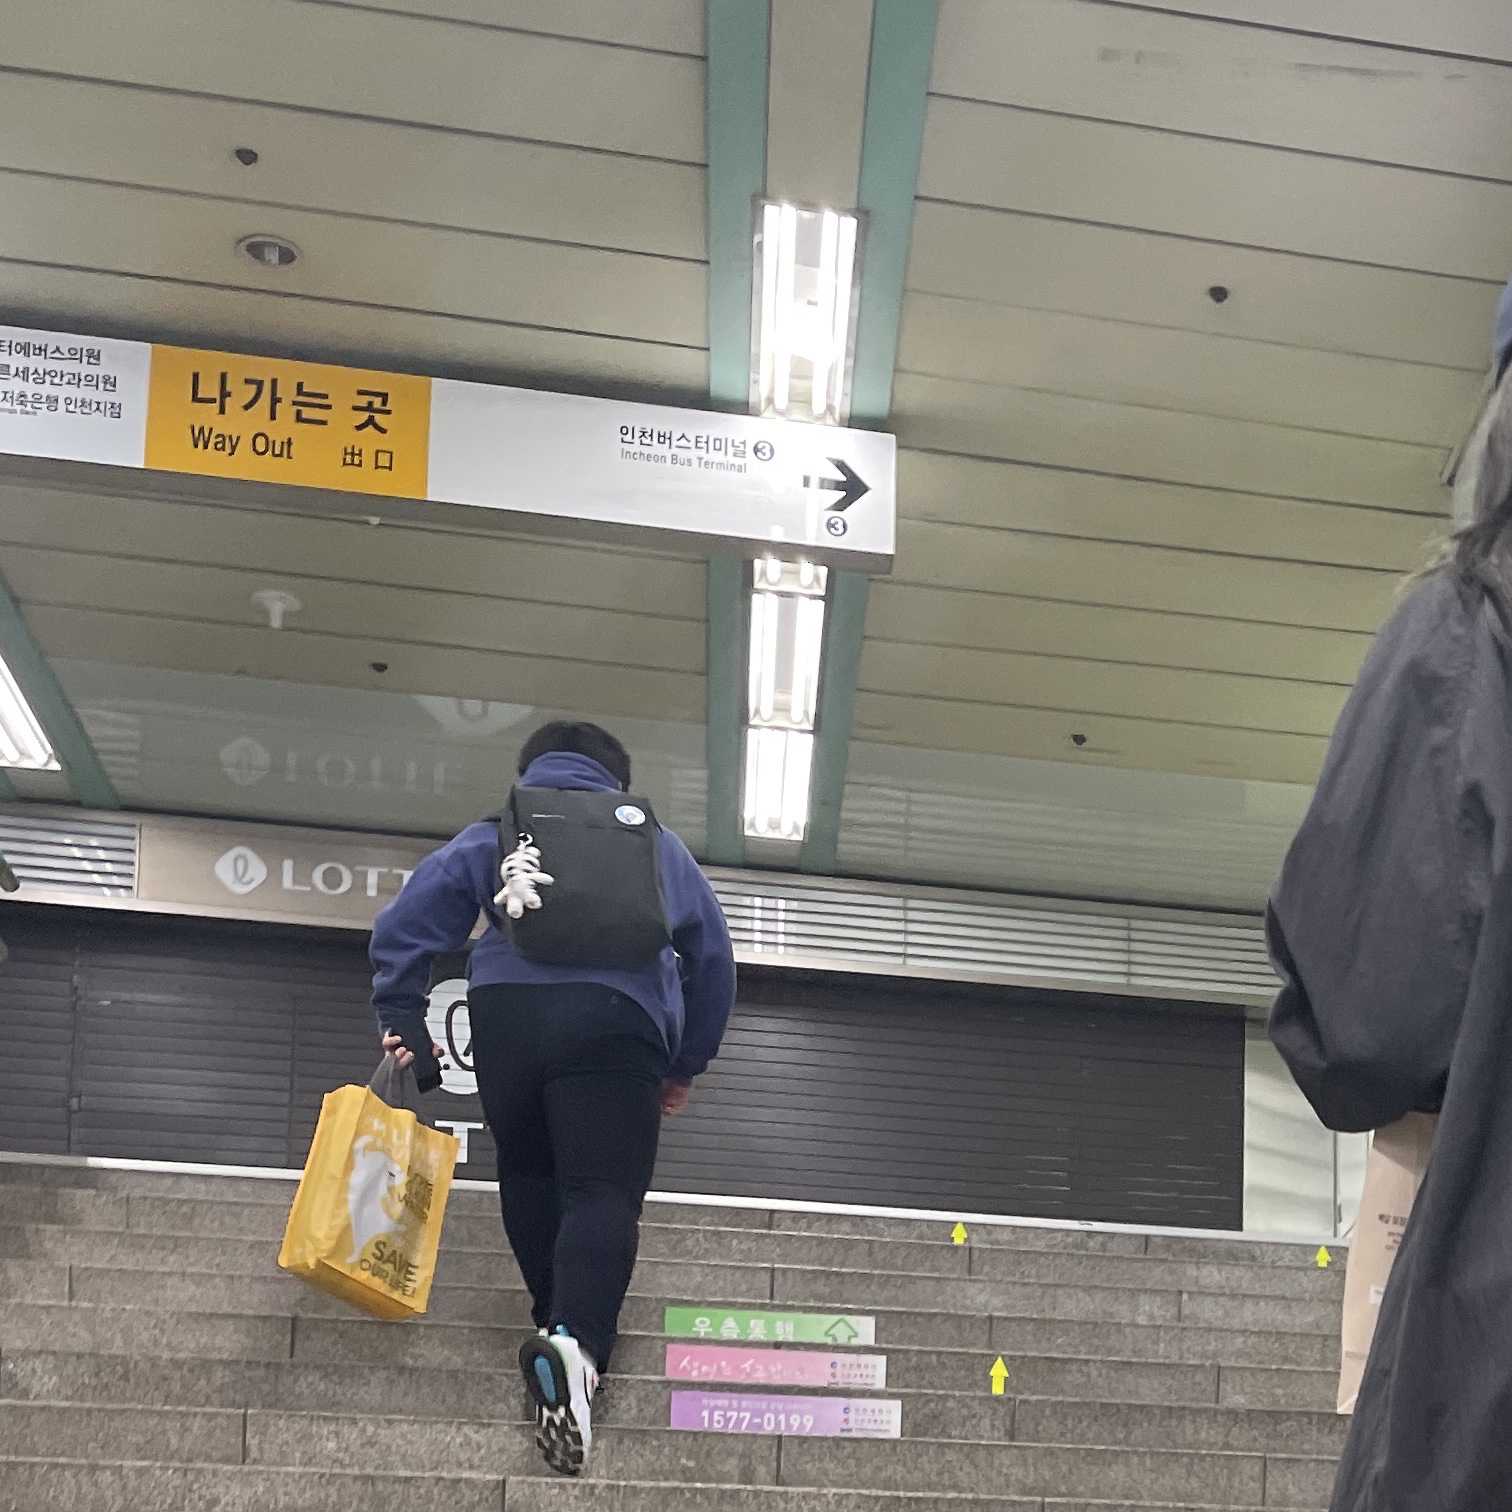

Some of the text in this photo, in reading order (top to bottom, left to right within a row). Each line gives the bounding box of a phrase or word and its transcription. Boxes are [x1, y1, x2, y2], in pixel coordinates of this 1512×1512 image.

[64, 396, 122, 419] 인천지점
[191, 371, 392, 434] 나가는 곳
[190, 424, 293, 459] Way Out
[620, 425, 747, 459] 인천버스터미널
[342, 444, 394, 471] 出口
[621, 448, 747, 474] Incheon Bus Terminal
[372, 1240, 420, 1284] SAVE
[700, 1408, 814, 1432] 1577-0199
